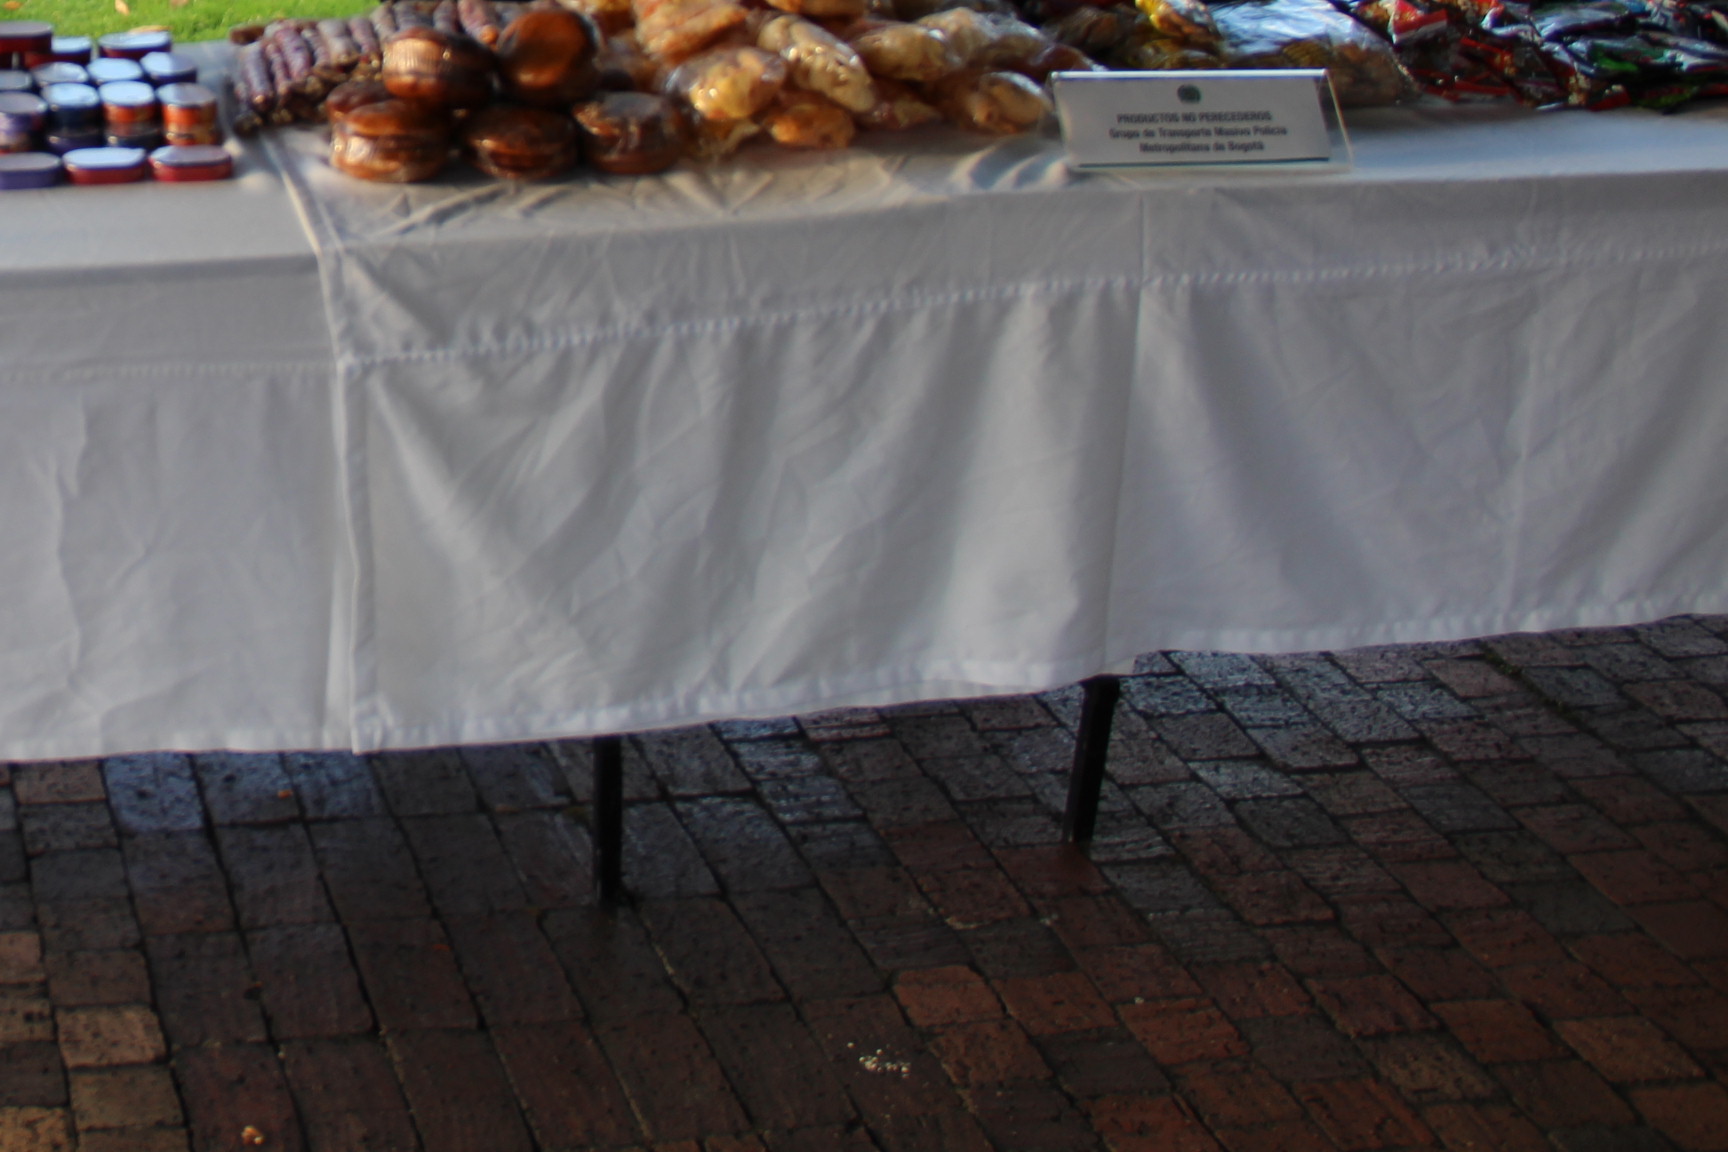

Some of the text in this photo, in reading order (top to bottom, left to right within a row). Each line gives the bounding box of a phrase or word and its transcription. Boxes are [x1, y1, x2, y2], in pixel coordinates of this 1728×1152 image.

[1117, 111, 1272, 124] PRODUCTOS NO PERECEDEROS
[1109, 128, 1140, 140] Grupo
[1143, 128, 1156, 138] de
[1158, 127, 1212, 139] Transporte
[1140, 142, 1210, 154] Metropolitana
[1213, 142, 1226, 152] de
